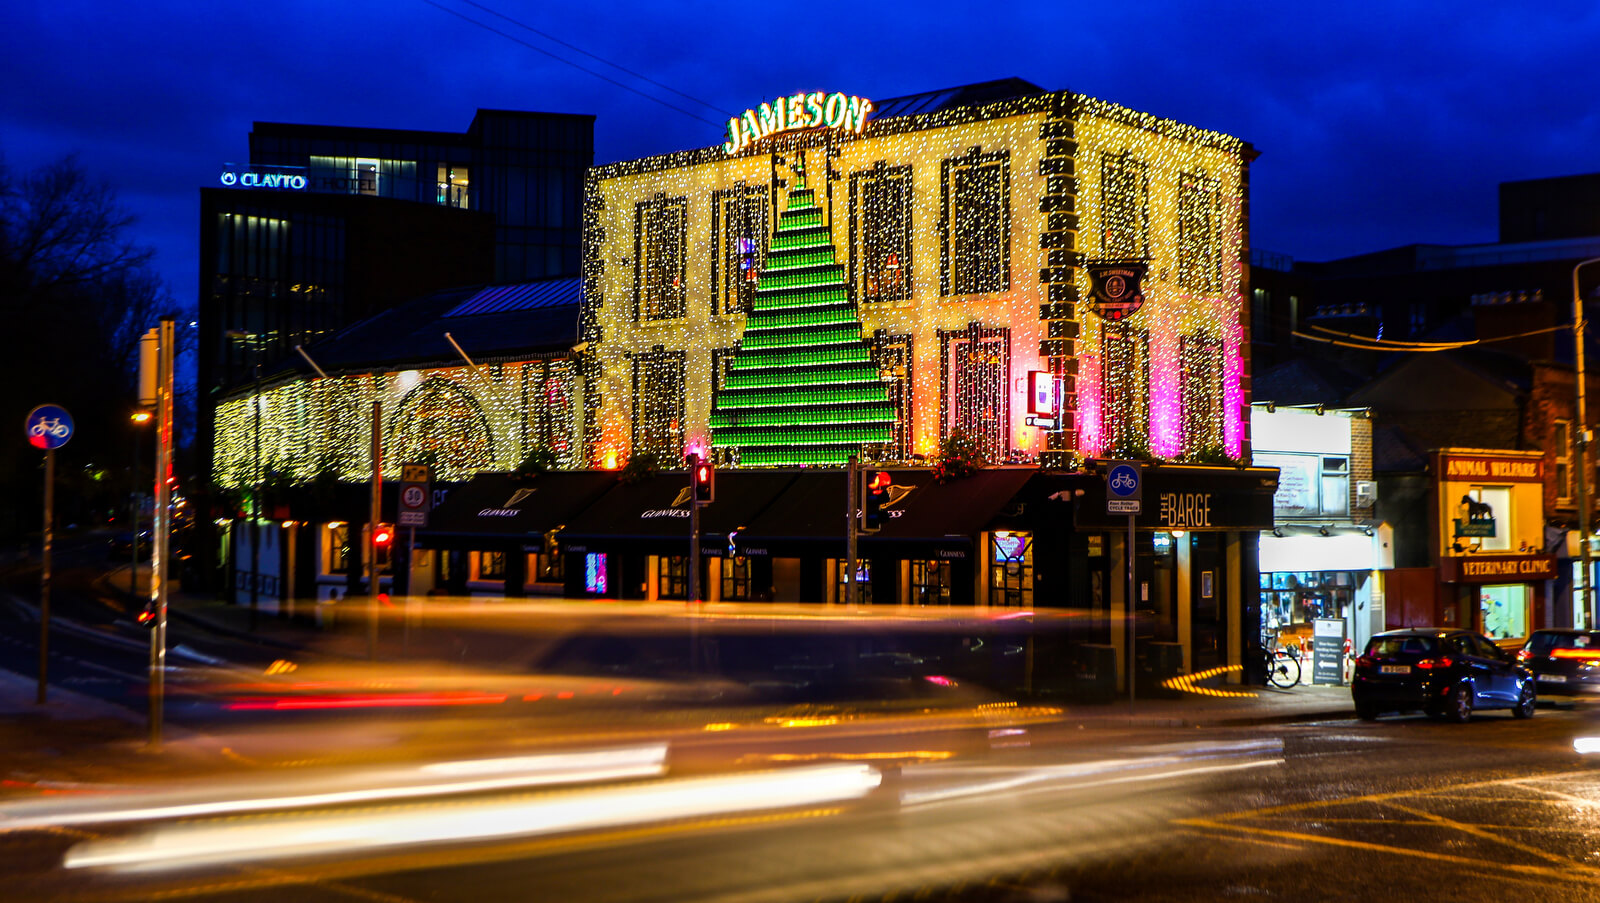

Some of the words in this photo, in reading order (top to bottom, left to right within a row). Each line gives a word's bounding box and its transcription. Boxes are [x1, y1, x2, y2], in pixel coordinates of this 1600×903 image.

[722, 91, 873, 154] JAMESON
[1447, 460, 1489, 476] ANIMAL
[1490, 461, 1537, 478] WELFARE
[408, 490, 421, 501] 30
[640, 508, 691, 519] GUINNESS
[1160, 492, 1169, 521] THE
[1168, 493, 1212, 527] BARGE
[1463, 561, 1519, 576] VETERINARY
[1519, 559, 1551, 574] CLINIC
